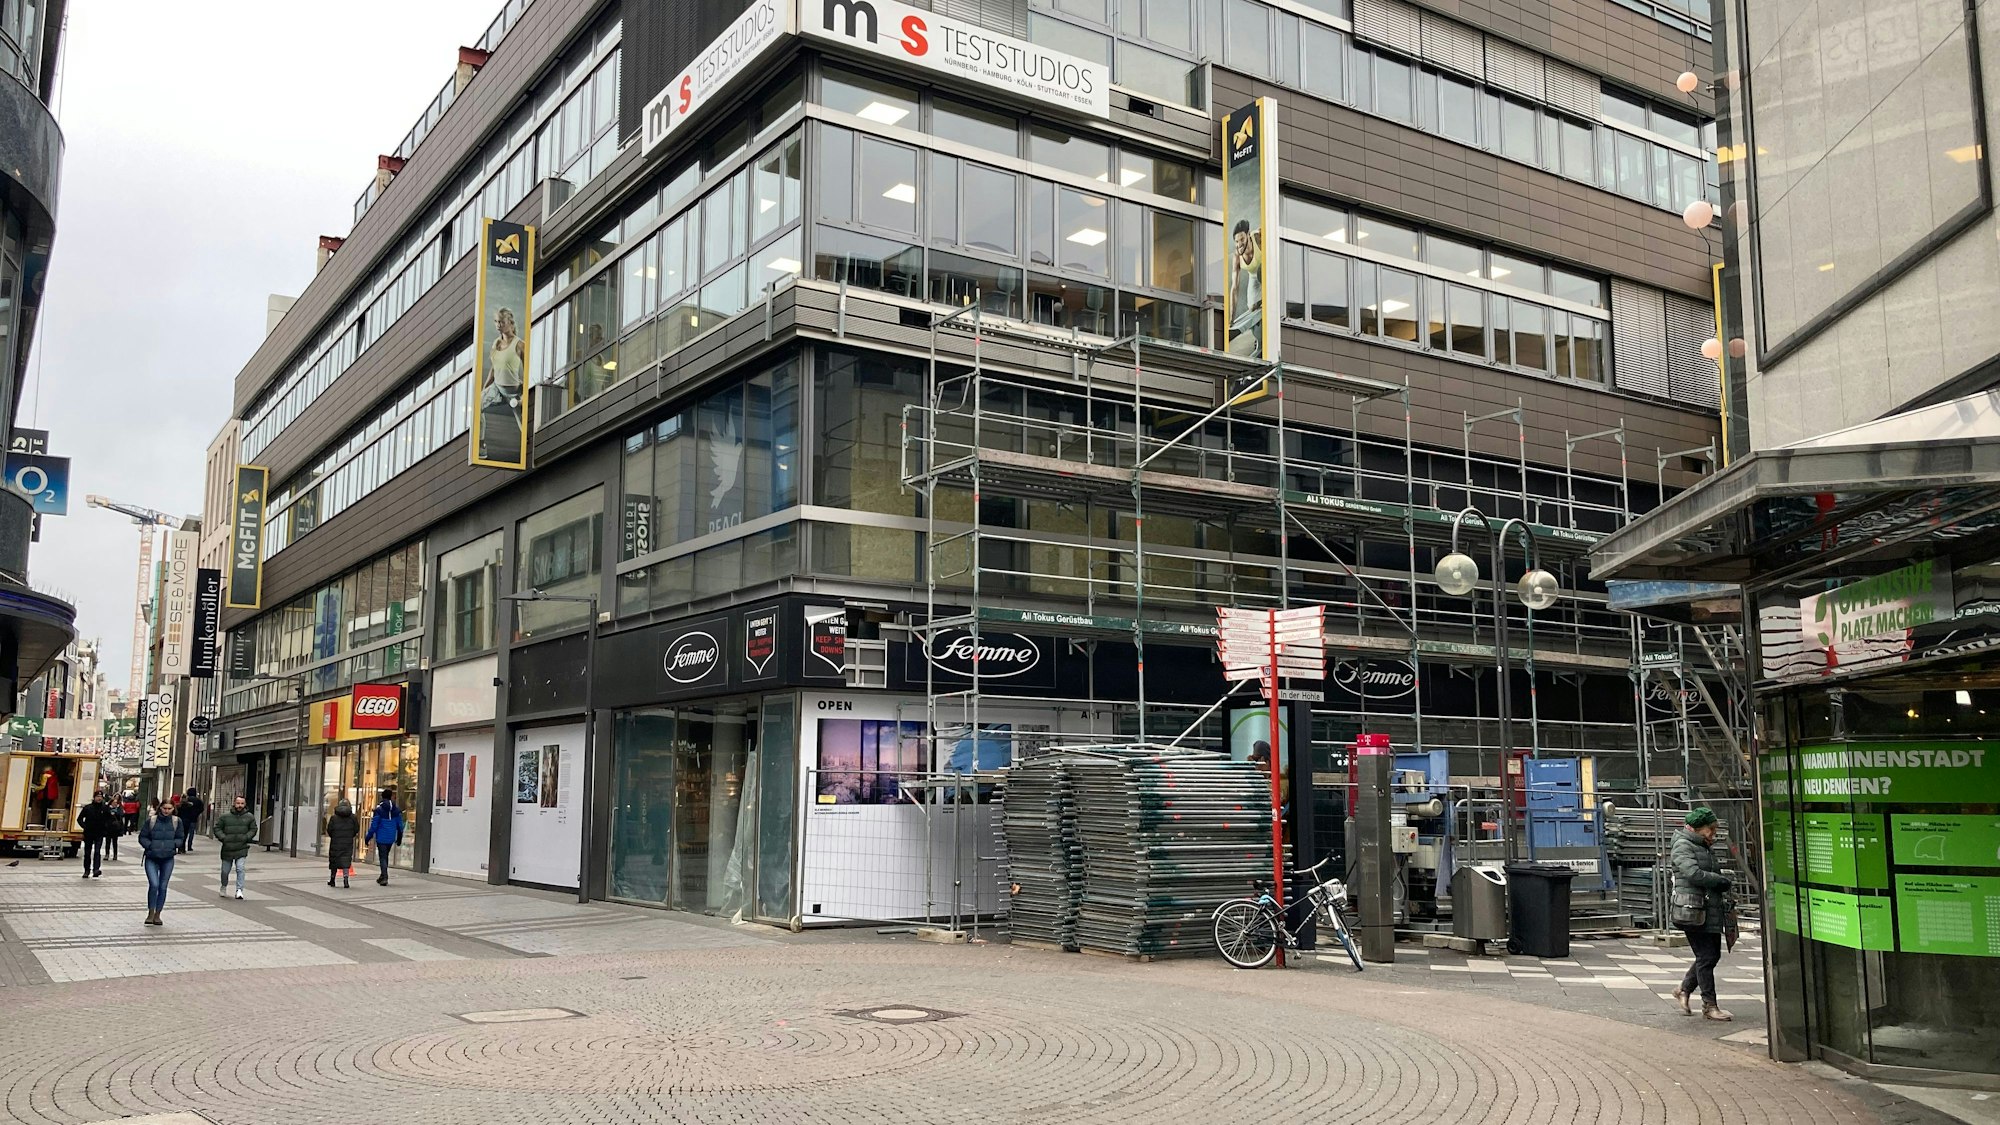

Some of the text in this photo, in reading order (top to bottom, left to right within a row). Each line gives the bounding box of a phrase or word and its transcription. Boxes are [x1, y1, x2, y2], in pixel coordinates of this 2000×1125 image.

[823, 0, 878, 44] m
[940, 25, 1093, 94] TESTSTUDIOS
[649, 94, 671, 144] m
[696, 0, 775, 89] TESTSTUDIOS
[944, 57, 1093, 106] NÜRNBERG HAMBURG KÖLN STUTTGART ESSEN
[1233, 144, 1254, 161] McFIT
[495, 254, 520, 266] McFIT
[1306, 494, 1319, 504] ALI
[1320, 497, 1345, 507] TOKUS
[237, 507, 259, 570] McFIT
[173, 538, 188, 585] MORE
[196, 577, 218, 670] hunkemöller
[819, 616, 839, 625] NTEN
[1032, 613, 1055, 623] Tokus
[1056, 614, 1093, 625] Gerüstbau
[1841, 616, 1873, 643] PLATZ
[1876, 603, 1935, 635] MACHEN!
[815, 635, 832, 644] KEEP
[1190, 626, 1210, 634] Tokus
[1281, 690, 1287, 698] In
[1288, 691, 1300, 699] der
[356, 697, 398, 716] LEGO
[817, 700, 853, 711] OPEN
[145, 701, 159, 762] MANGO
[156, 692, 173, 759] MANGO
[1802, 752, 1838, 770] WARUM
[1838, 749, 1985, 769] INNENSTADT
[1803, 777, 1823, 795] NEU
[1823, 776, 1892, 796] DENKEN?
